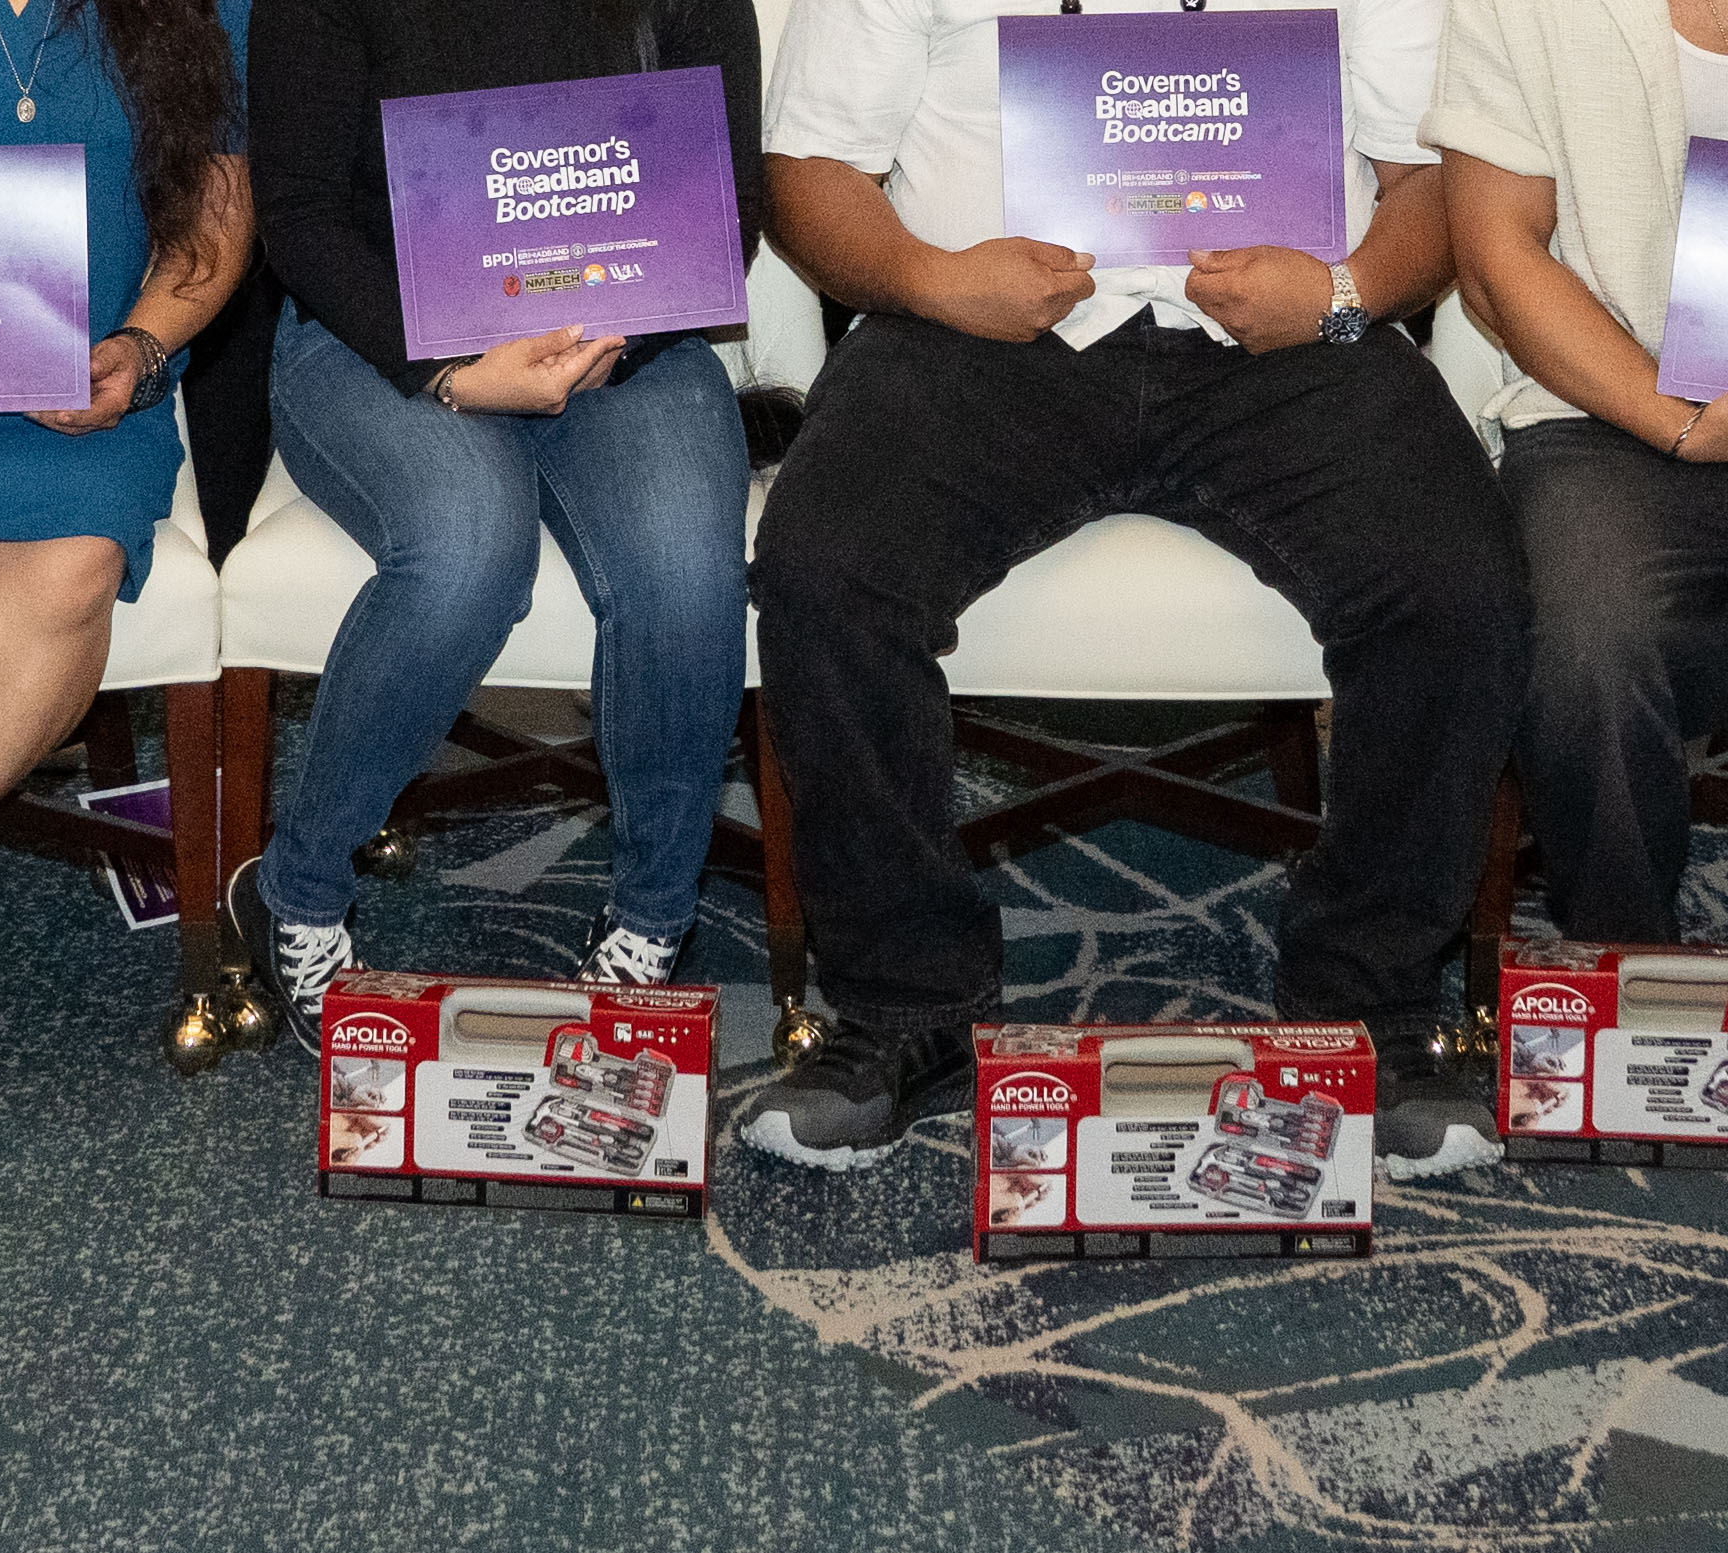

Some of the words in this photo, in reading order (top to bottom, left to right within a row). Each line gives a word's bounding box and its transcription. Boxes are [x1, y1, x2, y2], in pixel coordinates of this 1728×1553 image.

[1101, 68, 1241, 95] Governor's
[1103, 119, 1243, 146] Bootcamp
[490, 135, 631, 173] Governor's
[1087, 173, 1117, 186] BPD
[496, 189, 636, 223] Bootcamp
[482, 252, 513, 268] BPD
[1512, 996, 1588, 1015] APOLLO
[331, 1026, 408, 1045] APOLLO
[991, 1086, 1070, 1103] APOLLO
